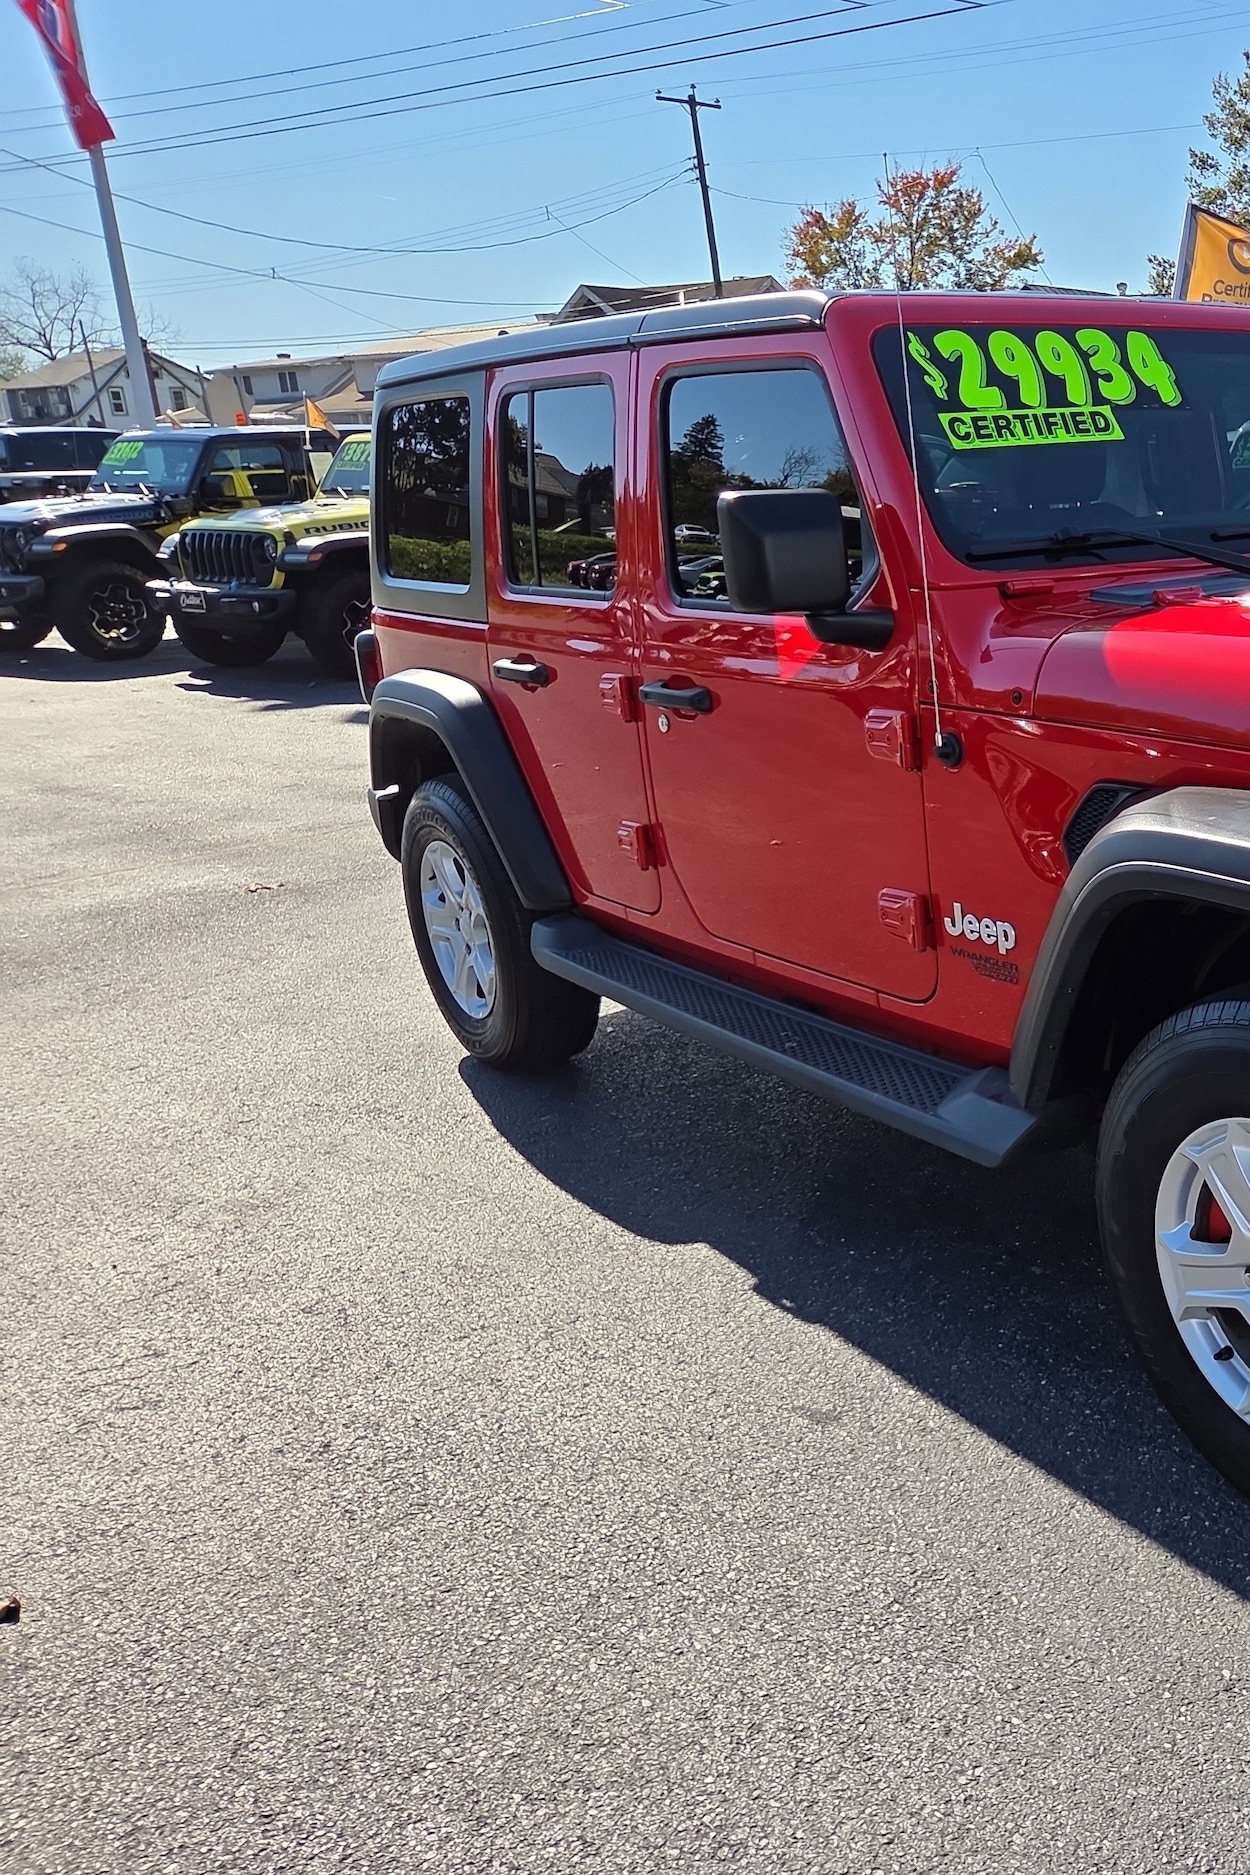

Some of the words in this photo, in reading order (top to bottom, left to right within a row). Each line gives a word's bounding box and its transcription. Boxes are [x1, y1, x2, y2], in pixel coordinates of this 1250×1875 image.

[907, 329, 1183, 409] $29934
[947, 411, 1115, 442] CERTIFIED
[943, 901, 1017, 956] Jeep
[950, 946, 1019, 972] WRANGLER
